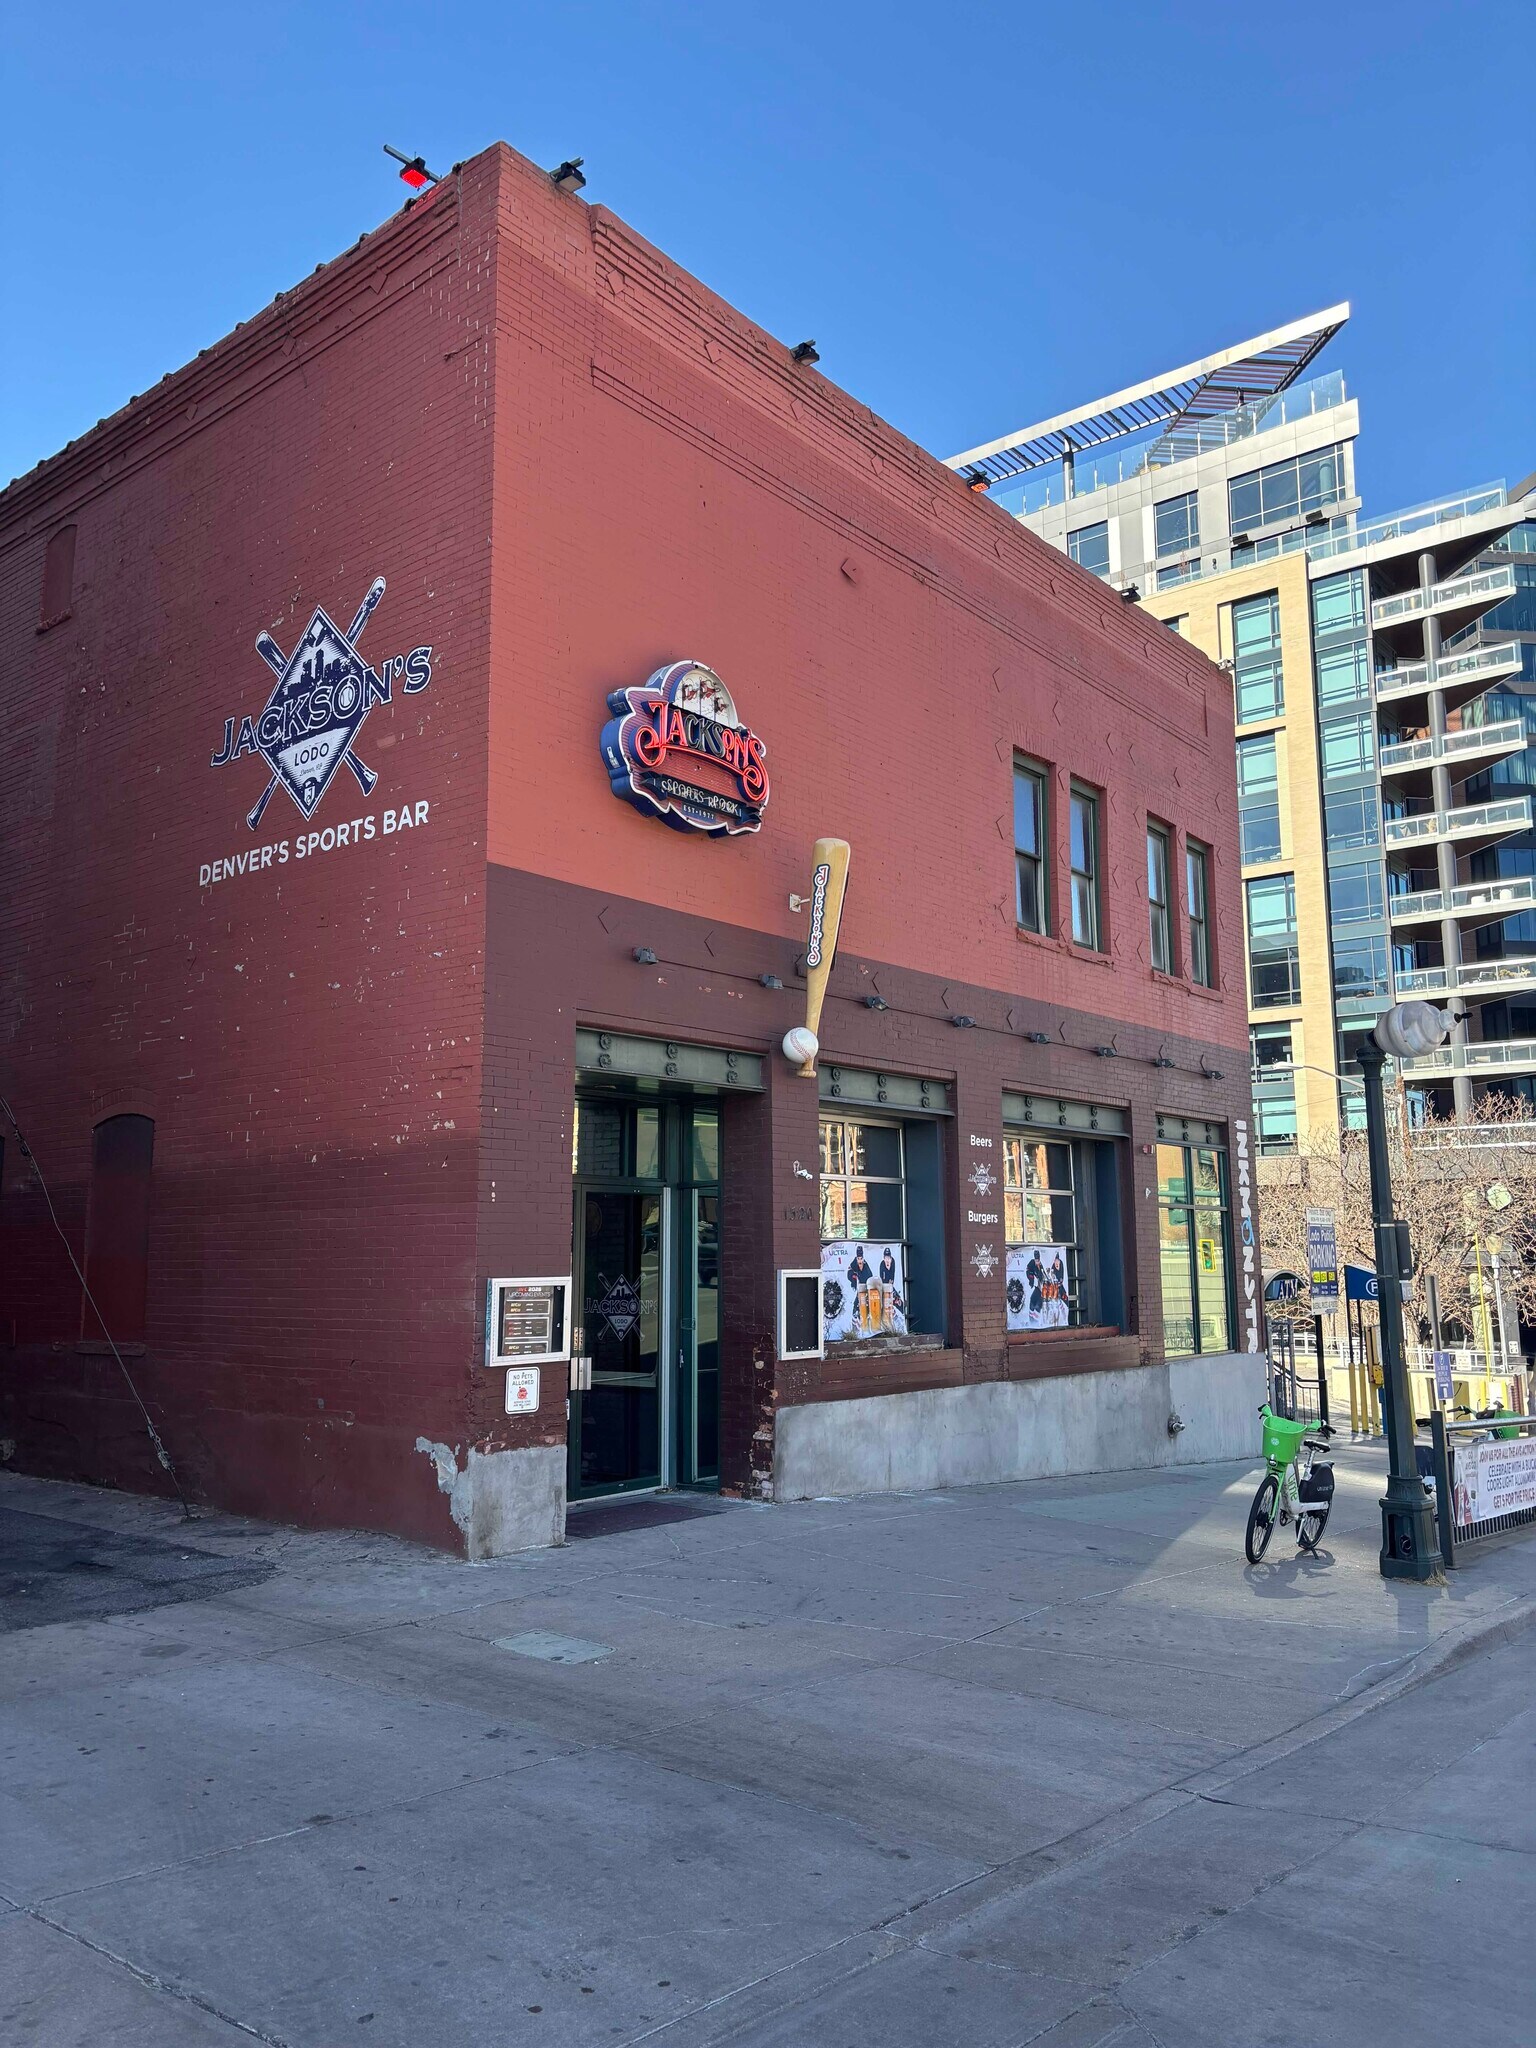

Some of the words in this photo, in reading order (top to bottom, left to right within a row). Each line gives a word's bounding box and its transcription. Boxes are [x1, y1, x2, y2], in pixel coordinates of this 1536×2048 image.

[209, 645, 432, 767] JACKSON'S
[294, 742, 330, 767] LODO
[199, 840, 290, 886] DENVER'S
[295, 815, 376, 858] SPORTS
[382, 800, 430, 835] BAR
[970, 1134, 993, 1147] Beers
[968, 1210, 998, 1225] Burgers
[1309, 1230, 1320, 1241] Lodo
[1310, 1244, 1336, 1268] PARKING
